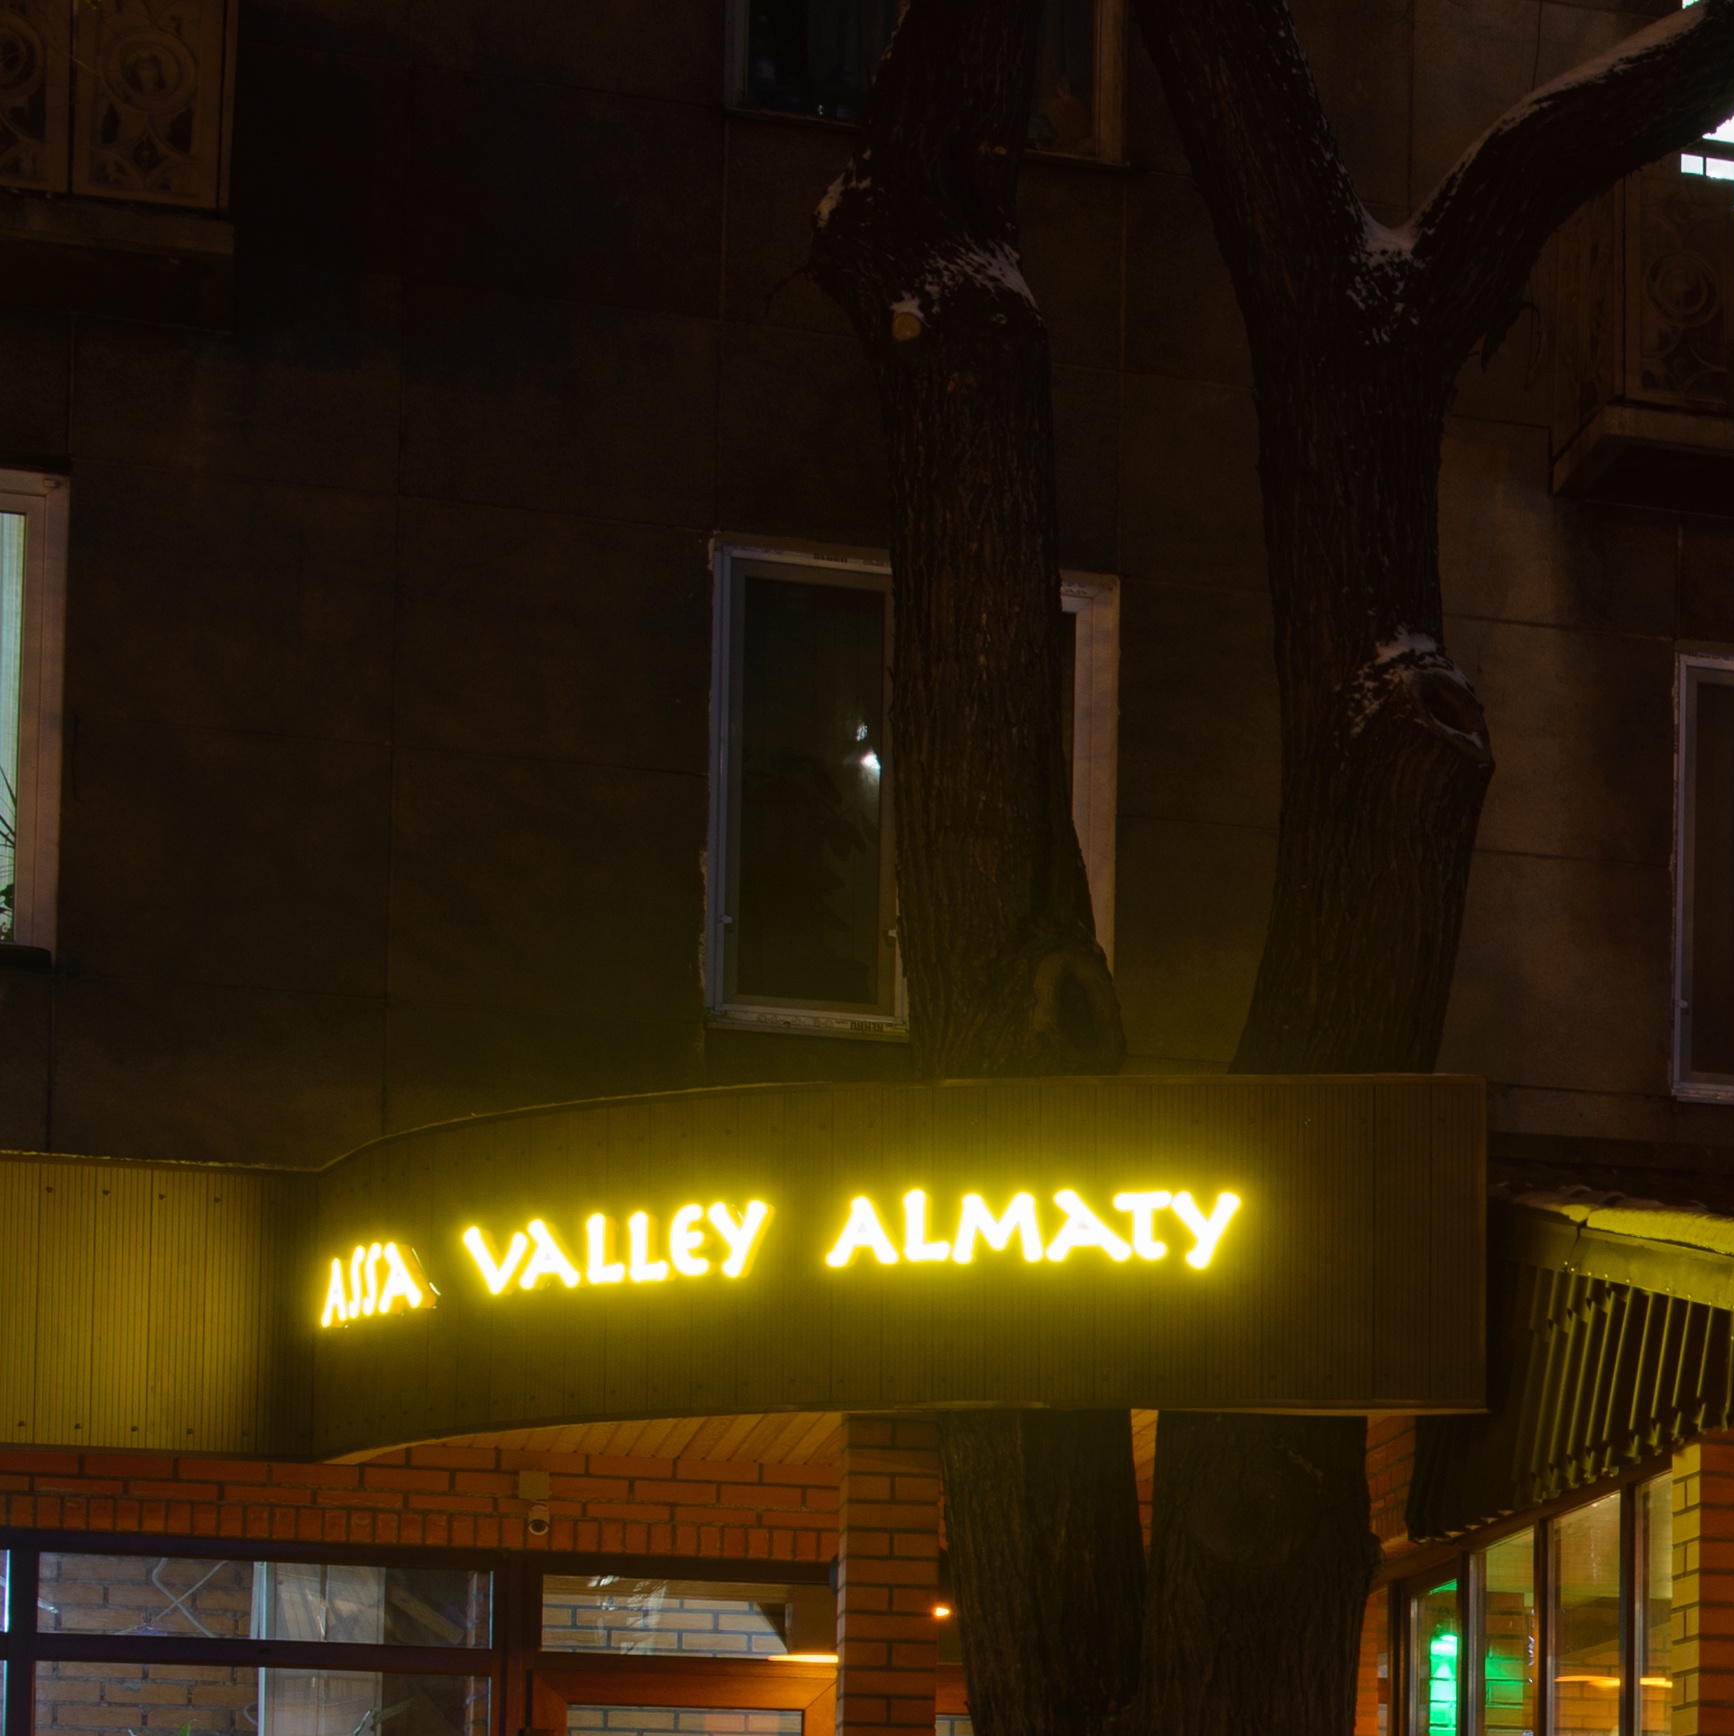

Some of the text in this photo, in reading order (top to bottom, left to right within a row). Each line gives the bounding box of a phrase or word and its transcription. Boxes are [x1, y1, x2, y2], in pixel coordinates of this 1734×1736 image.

[319, 1187, 1242, 1330] ASSA VALLEY ALMATY
